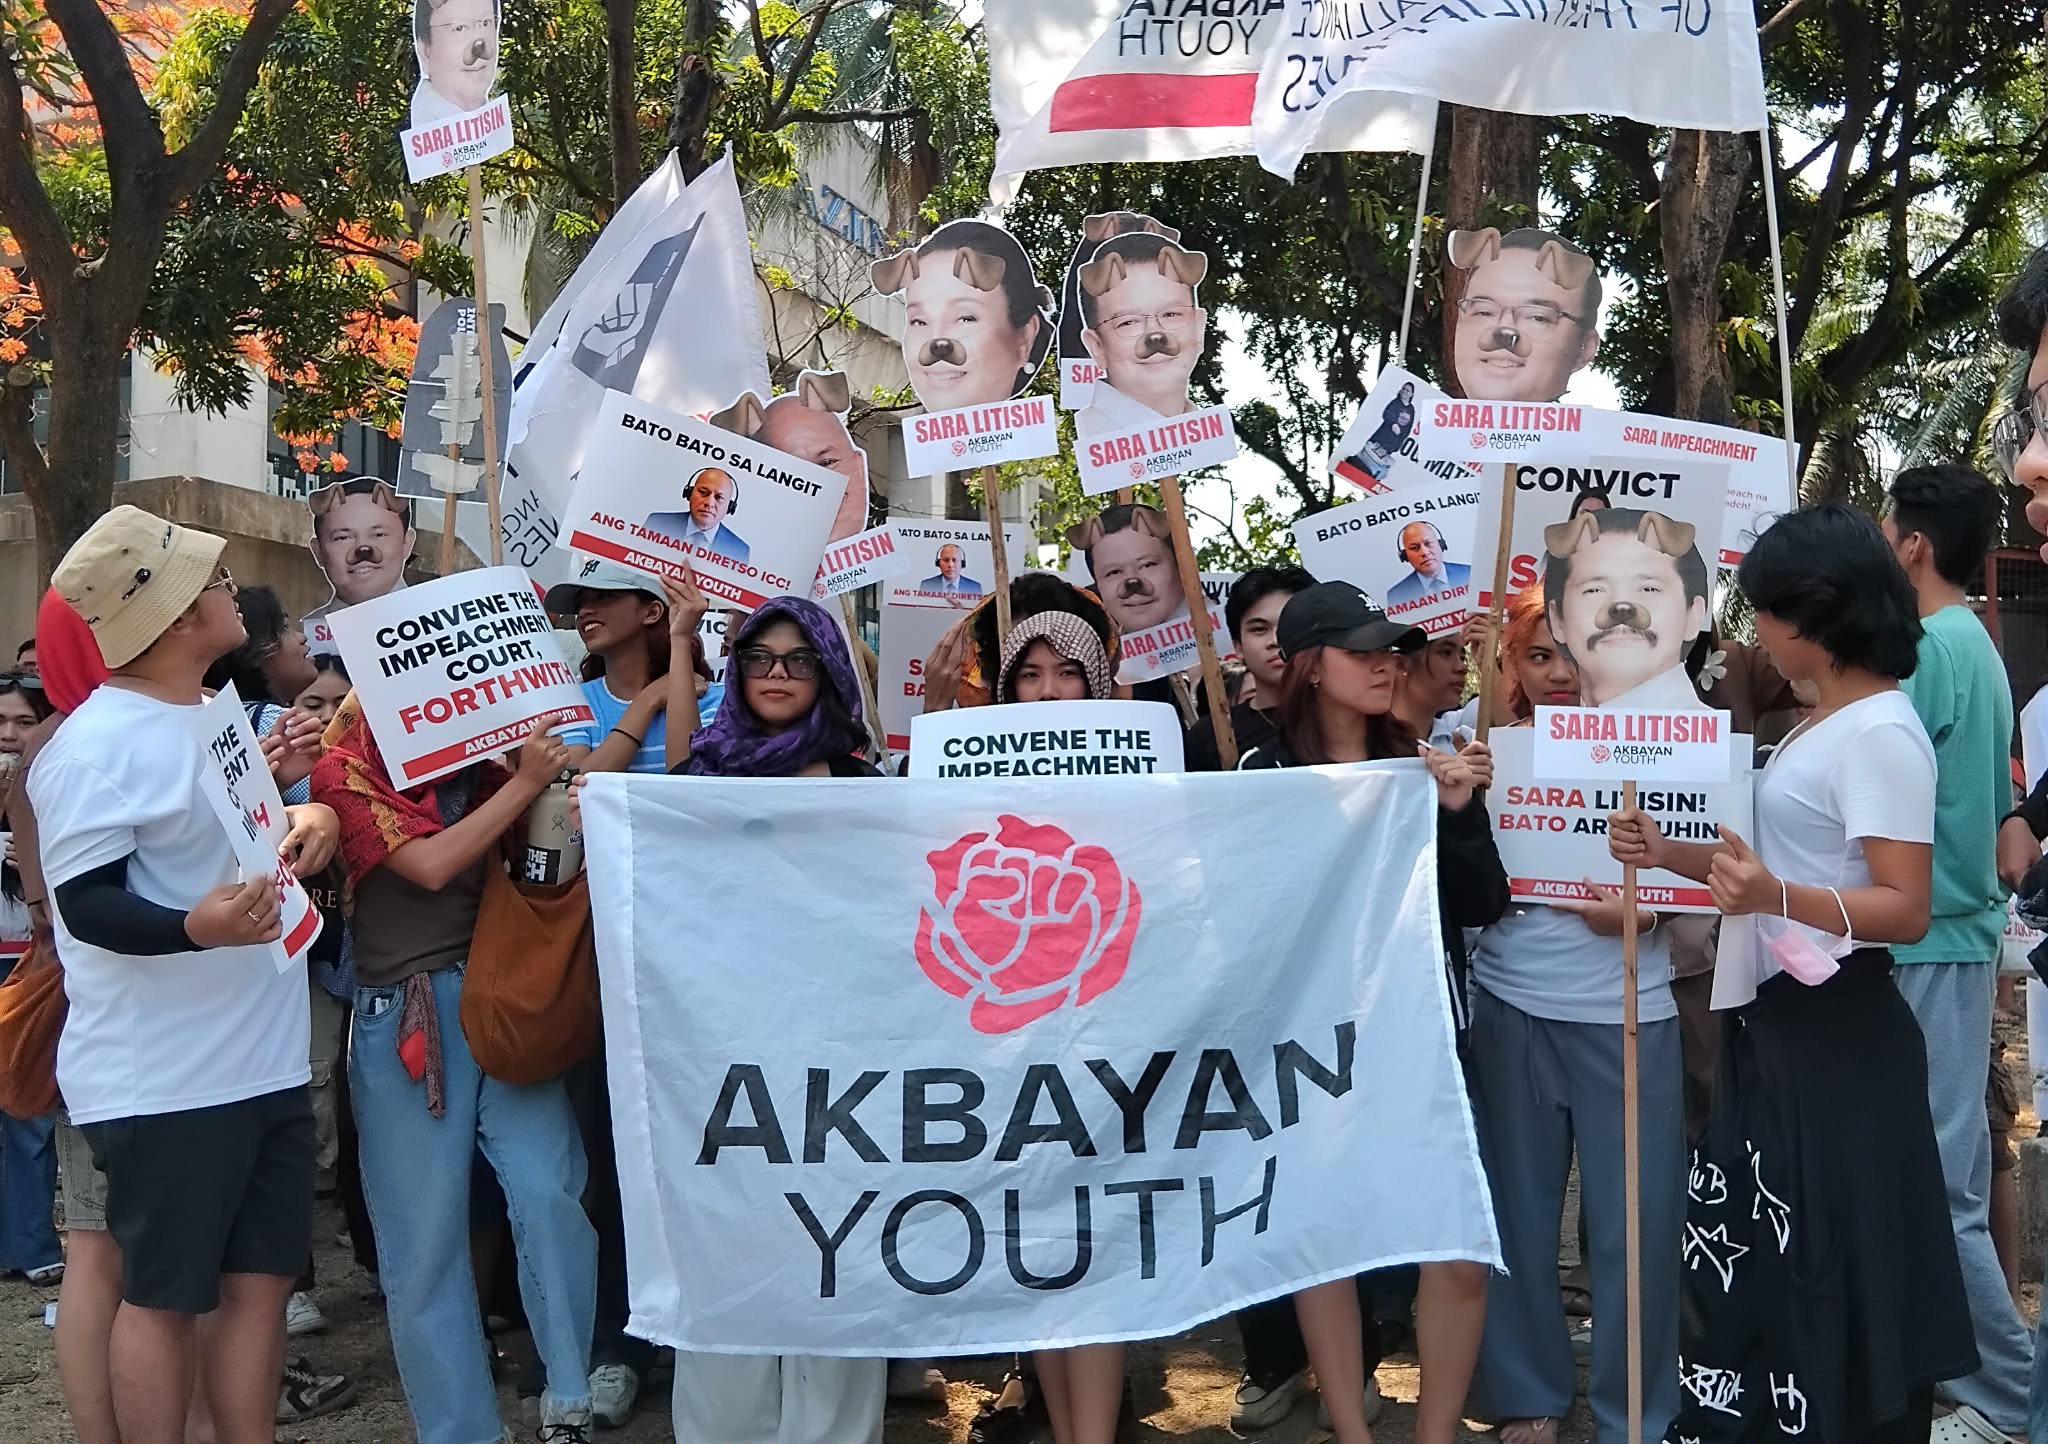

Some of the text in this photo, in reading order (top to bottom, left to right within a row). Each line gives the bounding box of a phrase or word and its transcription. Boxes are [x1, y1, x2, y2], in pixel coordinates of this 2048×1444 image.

[411, 104, 505, 158] SARA LITISIN
[453, 140, 487, 156] AKBAYAN
[454, 152, 482, 163] YOUTH
[915, 400, 1046, 444] SARA LITISIN
[1434, 403, 1582, 432] SARA LITISIN
[968, 431, 1013, 447] AKBAYAN
[968, 441, 1003, 455] YOUTH
[1088, 413, 1225, 468] SARA LITISIN
[1489, 433, 1542, 443] AKBAYAN
[1489, 441, 1526, 450] YOUTH
[1623, 426, 1758, 463] SARA IMPEACHMENT
[621, 413, 823, 498] BATO BATO SA LANGIT
[1146, 449, 1193, 466] AKBAYAN
[1147, 460, 1182, 474] YOUTH
[1515, 465, 1681, 499] CONVICT
[1756, 494, 1768, 502] na
[1317, 492, 1480, 542] BATO BATO SA LANGI
[924, 530, 951, 540] BATO
[954, 531, 968, 541] SA
[971, 532, 1011, 542] LANT
[590, 511, 625, 531] ANG
[630, 523, 694, 555] TAMAAN
[695, 547, 758, 579] DIRETSO
[761, 570, 791, 591] ICC!
[825, 532, 895, 574] LITISIN
[694, 573, 743, 601] YOUTH
[827, 566, 867, 587] AKBAYAN
[829, 578, 858, 593] YOUTH
[893, 589, 910, 597] ANG
[913, 590, 948, 600] TAMAAN
[1383, 593, 1438, 617] AMAAN
[375, 594, 510, 649] CONVENE
[512, 591, 540, 613] THE
[378, 615, 551, 678] IMPEACHMENT
[1159, 641, 1197, 659] AKBAYAN
[1160, 650, 1190, 665] YOUTH
[446, 639, 544, 682] COURT,
[398, 661, 576, 735] FORTHWITH
[1550, 713, 1718, 743] SARA LITISIN
[943, 729, 1151, 758] CONVENE THE
[1613, 745, 1673, 756] AKBAYAN
[938, 755, 1158, 778] IMPEACHMENT
[1613, 754, 1656, 765] YOUTH
[1507, 786, 1586, 808] SARA
[1499, 813, 1567, 832] BATO
[695, 1020, 1356, 1166] AKBAYAN
[784, 1155, 1278, 1299] YOUTH
